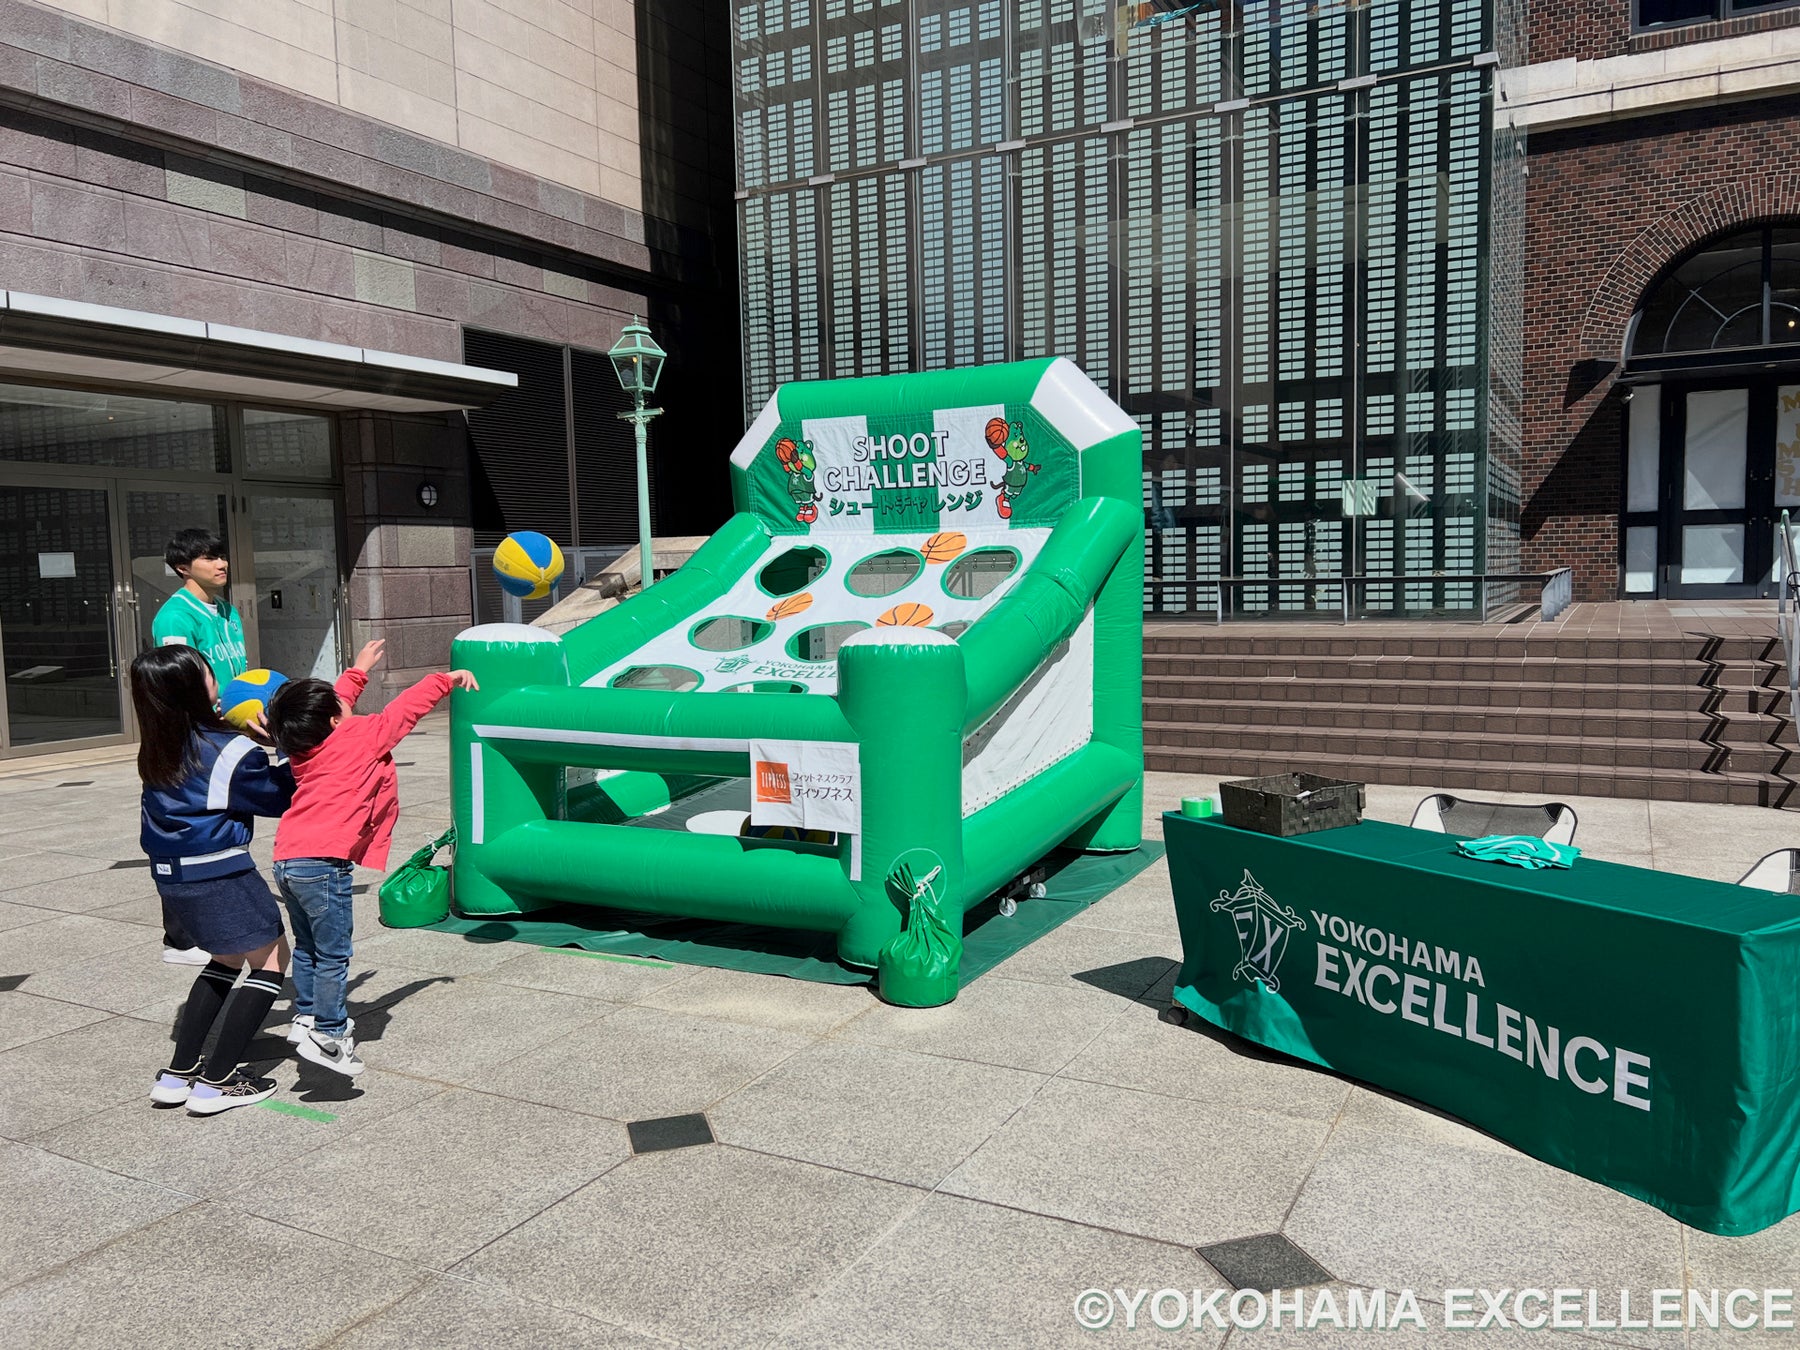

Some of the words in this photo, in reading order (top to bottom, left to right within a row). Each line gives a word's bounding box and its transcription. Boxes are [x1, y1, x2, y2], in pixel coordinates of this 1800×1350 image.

[852, 430, 949, 462] SHOOT
[823, 458, 987, 492] CHALLENGE
[829, 490, 984, 517] シュートチャレンジ
[753, 666, 837, 679] EXCELLE
[765, 660, 833, 671] YOKOHAMA
[1310, 910, 1486, 988] YOKOHAMA
[1314, 942, 1651, 1112] EXCELLENCE
